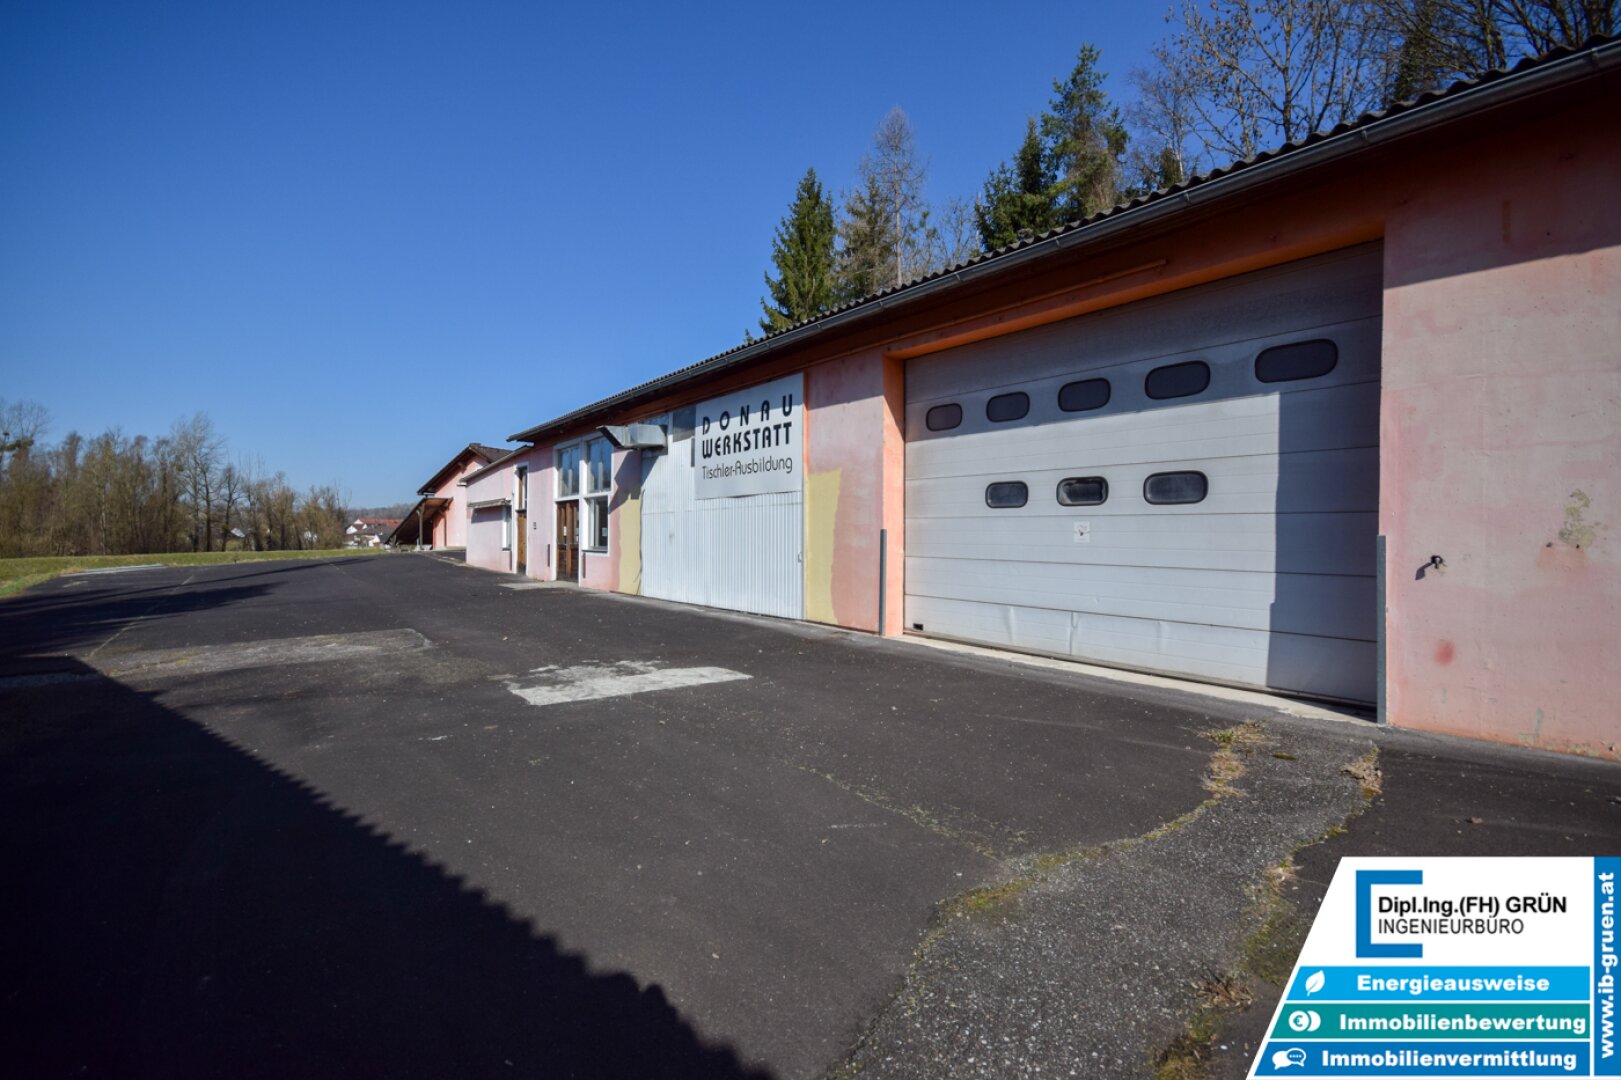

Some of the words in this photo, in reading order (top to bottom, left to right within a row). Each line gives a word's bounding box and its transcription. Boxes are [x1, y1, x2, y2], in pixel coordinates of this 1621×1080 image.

[702, 394, 793, 435] DONAU
[702, 421, 792, 459] WERKSTATT
[702, 456, 793, 480] Tischler-Ausbildung
